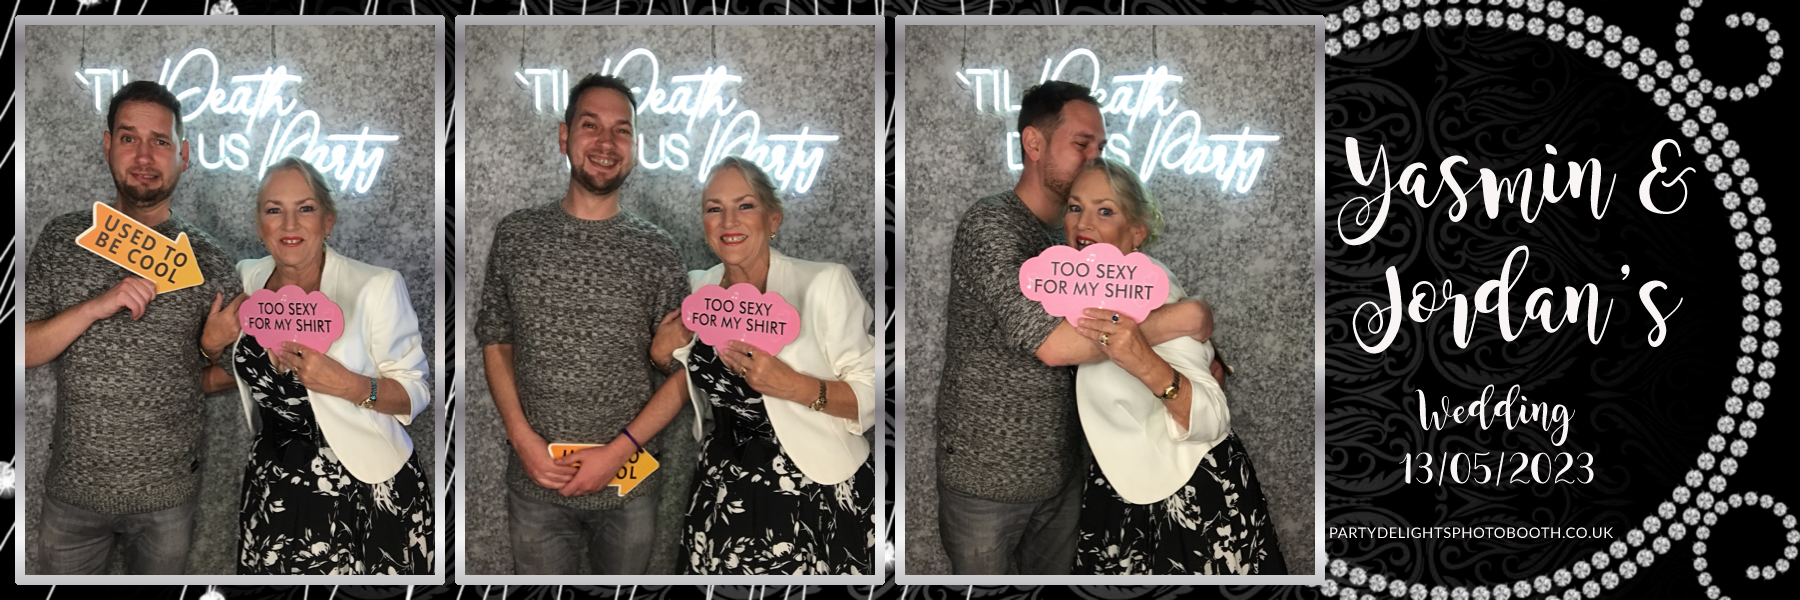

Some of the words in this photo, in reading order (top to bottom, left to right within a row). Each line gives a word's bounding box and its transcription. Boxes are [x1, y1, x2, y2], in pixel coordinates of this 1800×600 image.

[158, 47, 302, 134] Death
[198, 133, 250, 171] US
[258, 109, 399, 193] Party
[638, 133, 690, 171] US
[698, 109, 839, 193] Party
[1139, 109, 1280, 193] Party
[95, 231, 122, 255] BE
[127, 249, 177, 284] COOL
[104, 214, 157, 251] USED
[164, 244, 188, 267] TO
[1034, 279, 1068, 295] FOR
[1073, 282, 1099, 296] MY
[1105, 283, 1154, 300] SHIRT
[1051, 261, 1090, 277] TOO
[1096, 263, 1138, 280] SEXY
[248, 317, 272, 330] FOR
[274, 318, 292, 331] MY
[296, 318, 332, 333] SHIRT
[257, 302, 285, 315] TOO
[288, 302, 318, 316] SEXY
[692, 312, 717, 327] FOR
[720, 316, 742, 330] MY
[746, 318, 787, 336] SHIRT
[704, 297, 734, 313] TOO
[739, 301, 773, 317] SEXY
